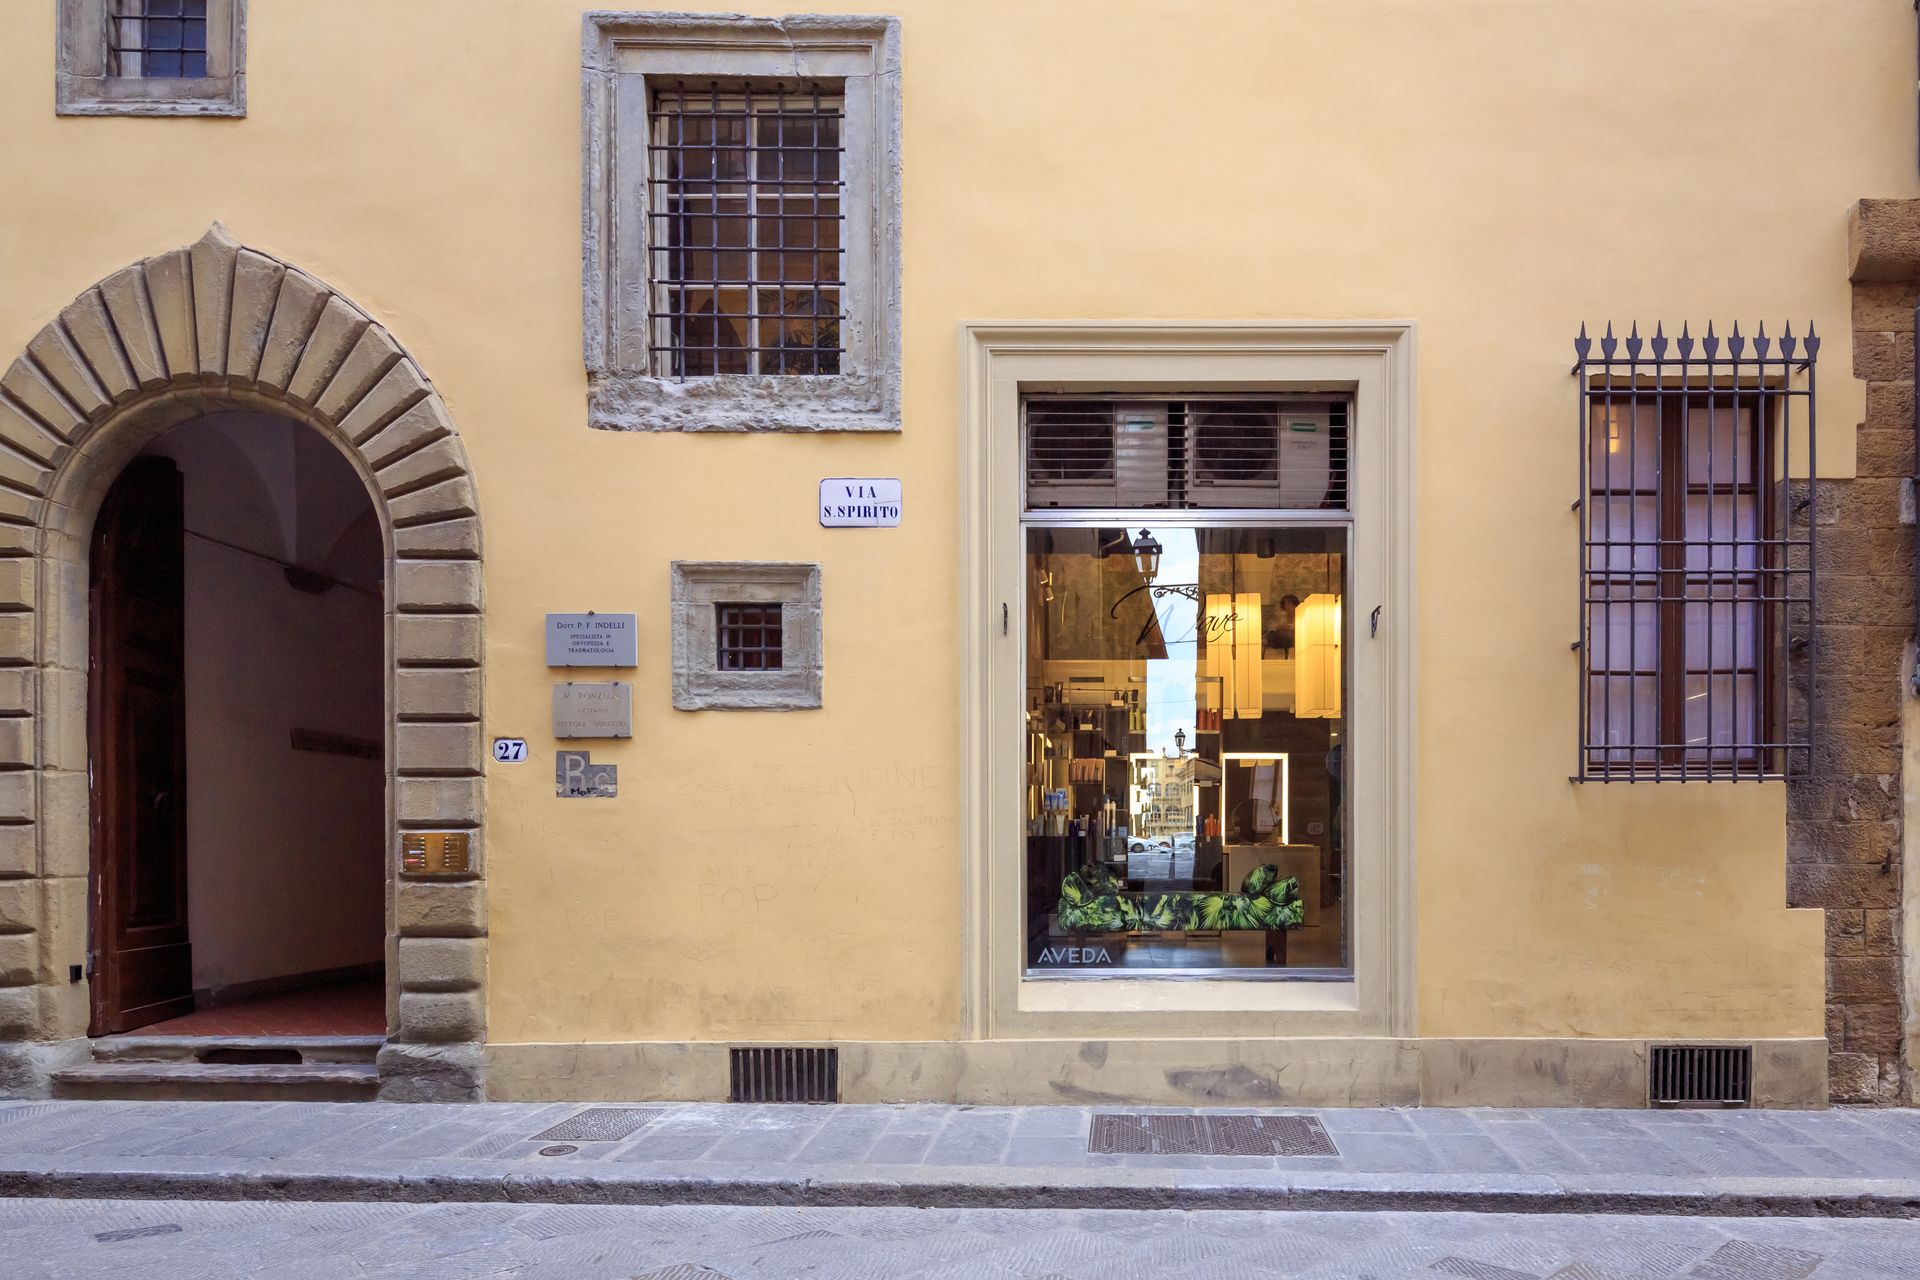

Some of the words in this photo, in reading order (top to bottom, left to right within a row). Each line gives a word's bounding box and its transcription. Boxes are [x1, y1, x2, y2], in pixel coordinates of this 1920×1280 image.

[845, 485, 877, 498] VIA
[823, 505, 899, 519] S.SPIRITO
[498, 742, 524, 760] 27
[697, 883, 779, 912] POP
[1037, 947, 1112, 964] AVEDA
